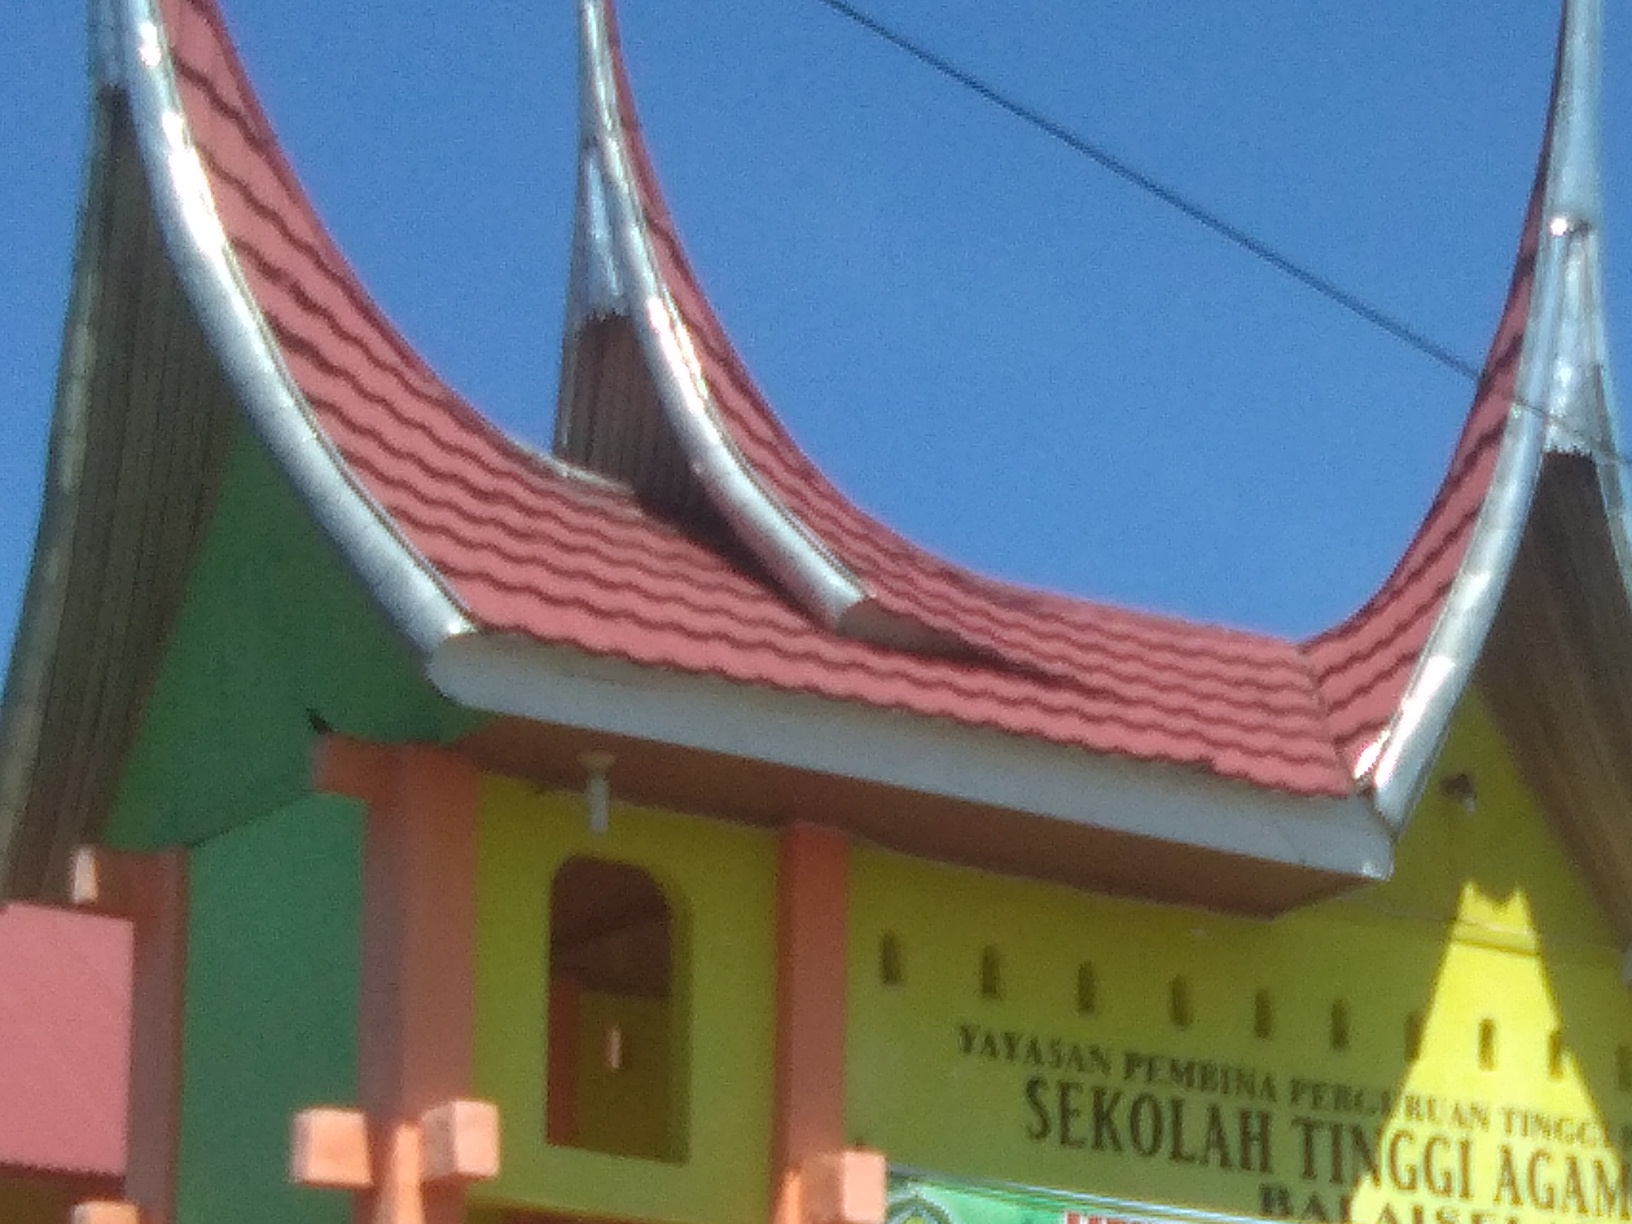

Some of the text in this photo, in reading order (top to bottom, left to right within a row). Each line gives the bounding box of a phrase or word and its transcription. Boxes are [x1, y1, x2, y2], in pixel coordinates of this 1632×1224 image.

[958, 1024, 1112, 1077] YAYASAN
[1124, 1052, 1277, 1103] PEMBINA
[1024, 1076, 1272, 1175] SEKOLAH
[1291, 1115, 1474, 1200] TINGGI
